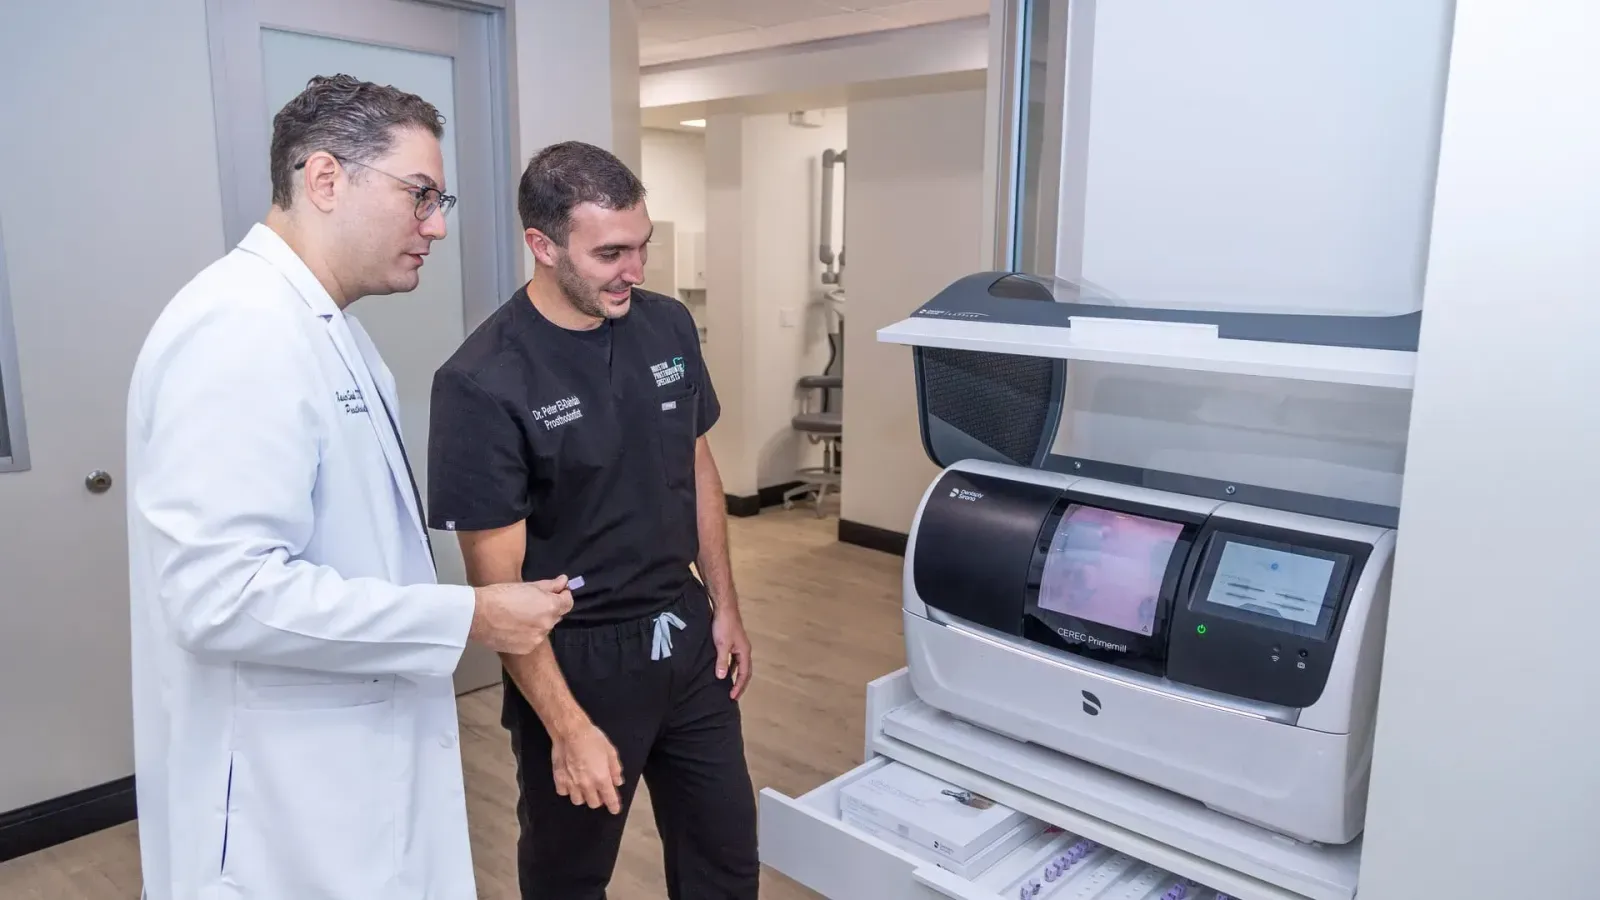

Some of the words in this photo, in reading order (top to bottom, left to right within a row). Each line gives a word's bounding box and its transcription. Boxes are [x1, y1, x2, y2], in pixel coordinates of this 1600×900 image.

[532, 410, 544, 420] Dr.
[541, 405, 558, 417] Peter
[960, 489, 984, 498] Dentsply
[1057, 627, 1087, 642] CEREC
[1088, 636, 1127, 653] Primemill
